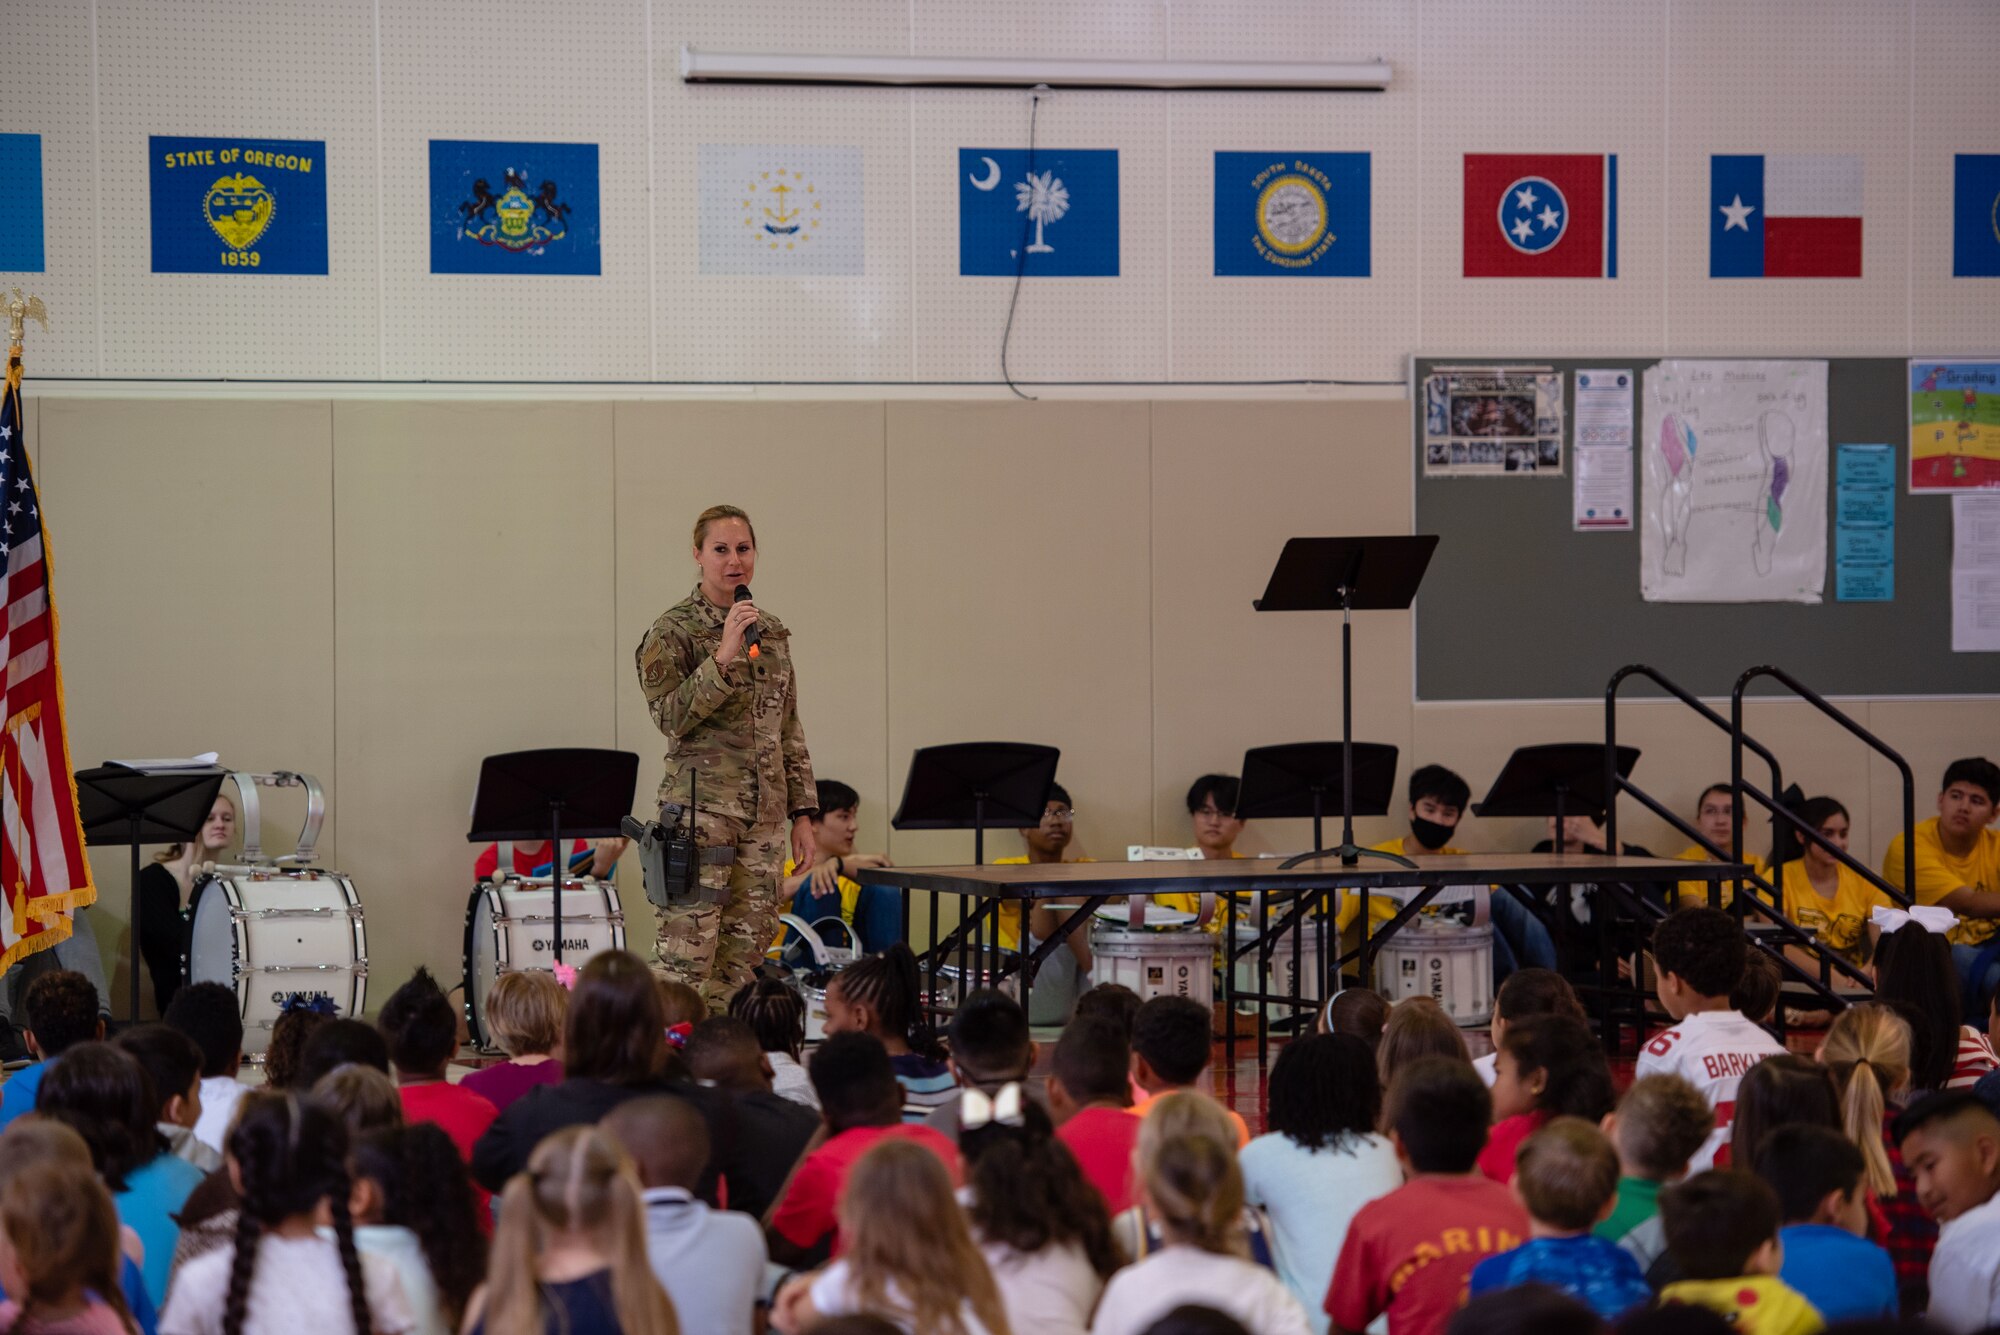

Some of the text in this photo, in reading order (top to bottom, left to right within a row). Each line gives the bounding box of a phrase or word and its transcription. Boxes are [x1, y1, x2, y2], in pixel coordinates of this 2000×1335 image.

[165, 148, 312, 172] STATE OF OREGON
[221, 251, 260, 267] 1859
[1946, 369, 1997, 386] Grading
[545, 938, 589, 951] YMAHA
[1703, 1053, 1777, 1079] BARK
